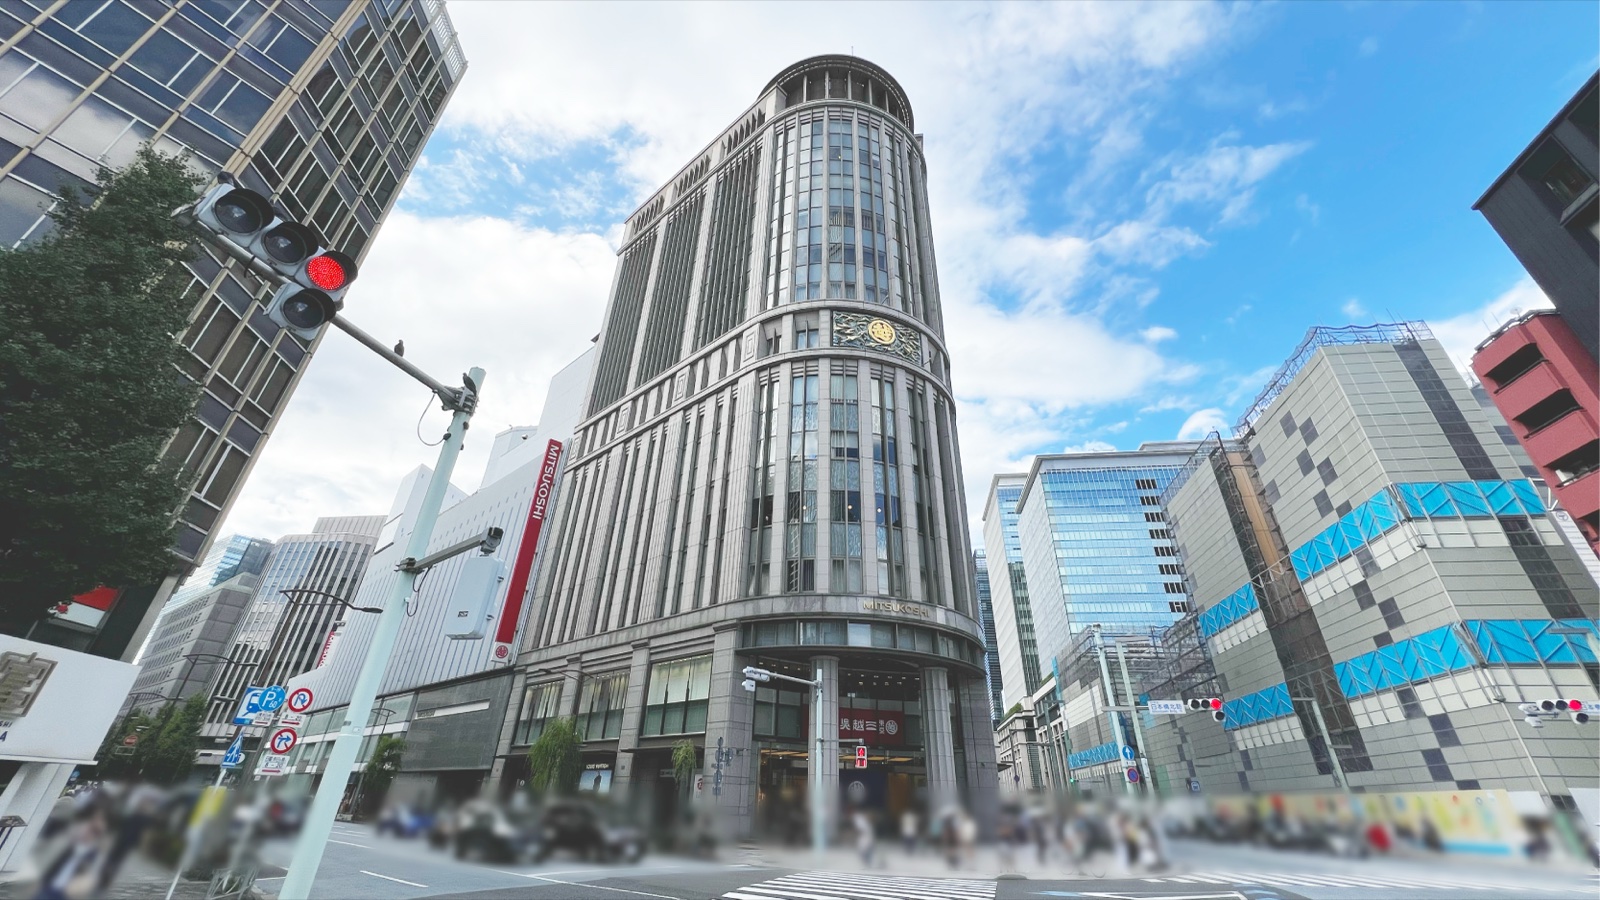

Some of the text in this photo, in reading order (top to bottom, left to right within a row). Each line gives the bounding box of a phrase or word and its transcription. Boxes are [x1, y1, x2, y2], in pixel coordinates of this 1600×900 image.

[532, 444, 560, 520] MITSUKOSHI
[863, 600, 930, 618] MITSUKOSHI
[263, 691, 276, 707] P
